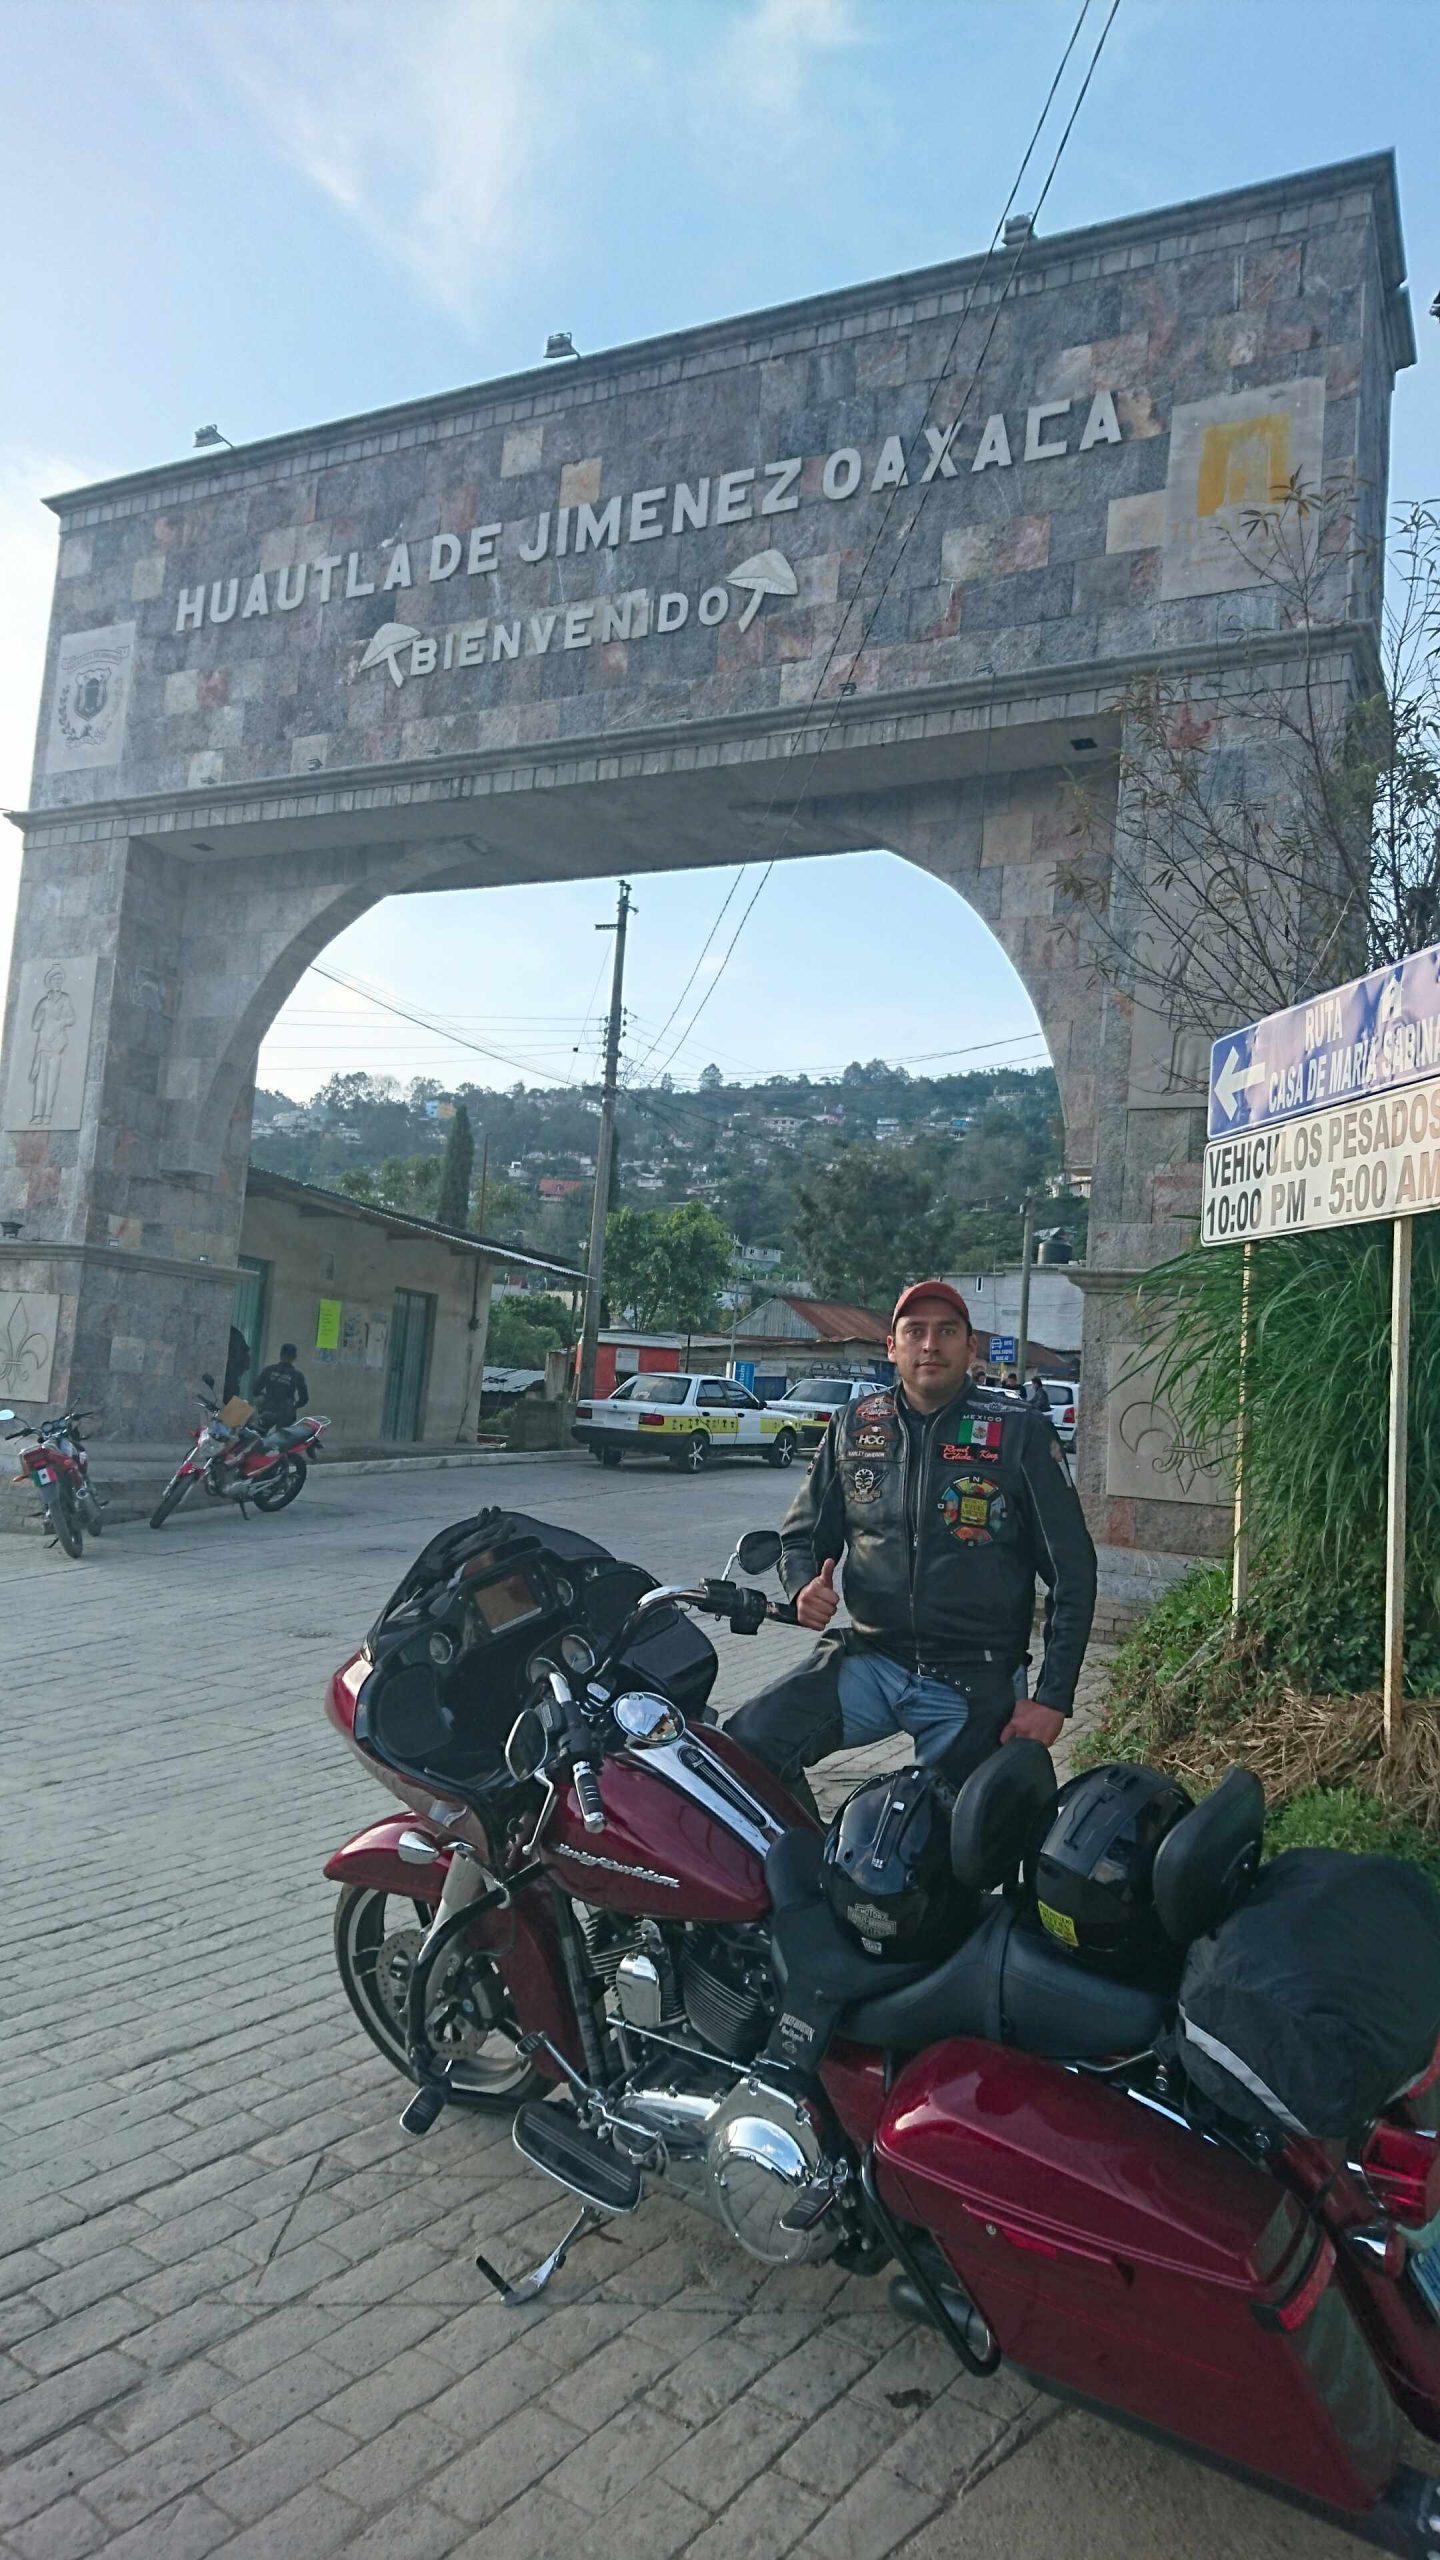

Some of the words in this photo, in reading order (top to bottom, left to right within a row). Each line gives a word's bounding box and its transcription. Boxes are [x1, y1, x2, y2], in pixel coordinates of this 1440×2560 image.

[175, 543, 412, 631] HUAUTLA
[429, 522, 502, 582] DE
[519, 456, 802, 562] JIMENEZ
[822, 390, 1122, 500] OAXACA
[1305, 997, 1343, 1050] RUTA
[1268, 1063, 1304, 1113] CASA
[1307, 1055, 1327, 1101] DE
[1329, 1039, 1378, 1093] MARIA
[1209, 1123, 1323, 1189] VEHICULOS
[1328, 1088, 1440, 1162] PESADOS
[1206, 1188, 1262, 1237] 10:00
[1270, 1179, 1307, 1226] PM
[1328, 1161, 1388, 1215] 5:00
[1395, 1149, 1440, 1204] AM
[858, 1434, 886, 1445] HOG
[962, 1414, 1002, 1422] MEXICO
